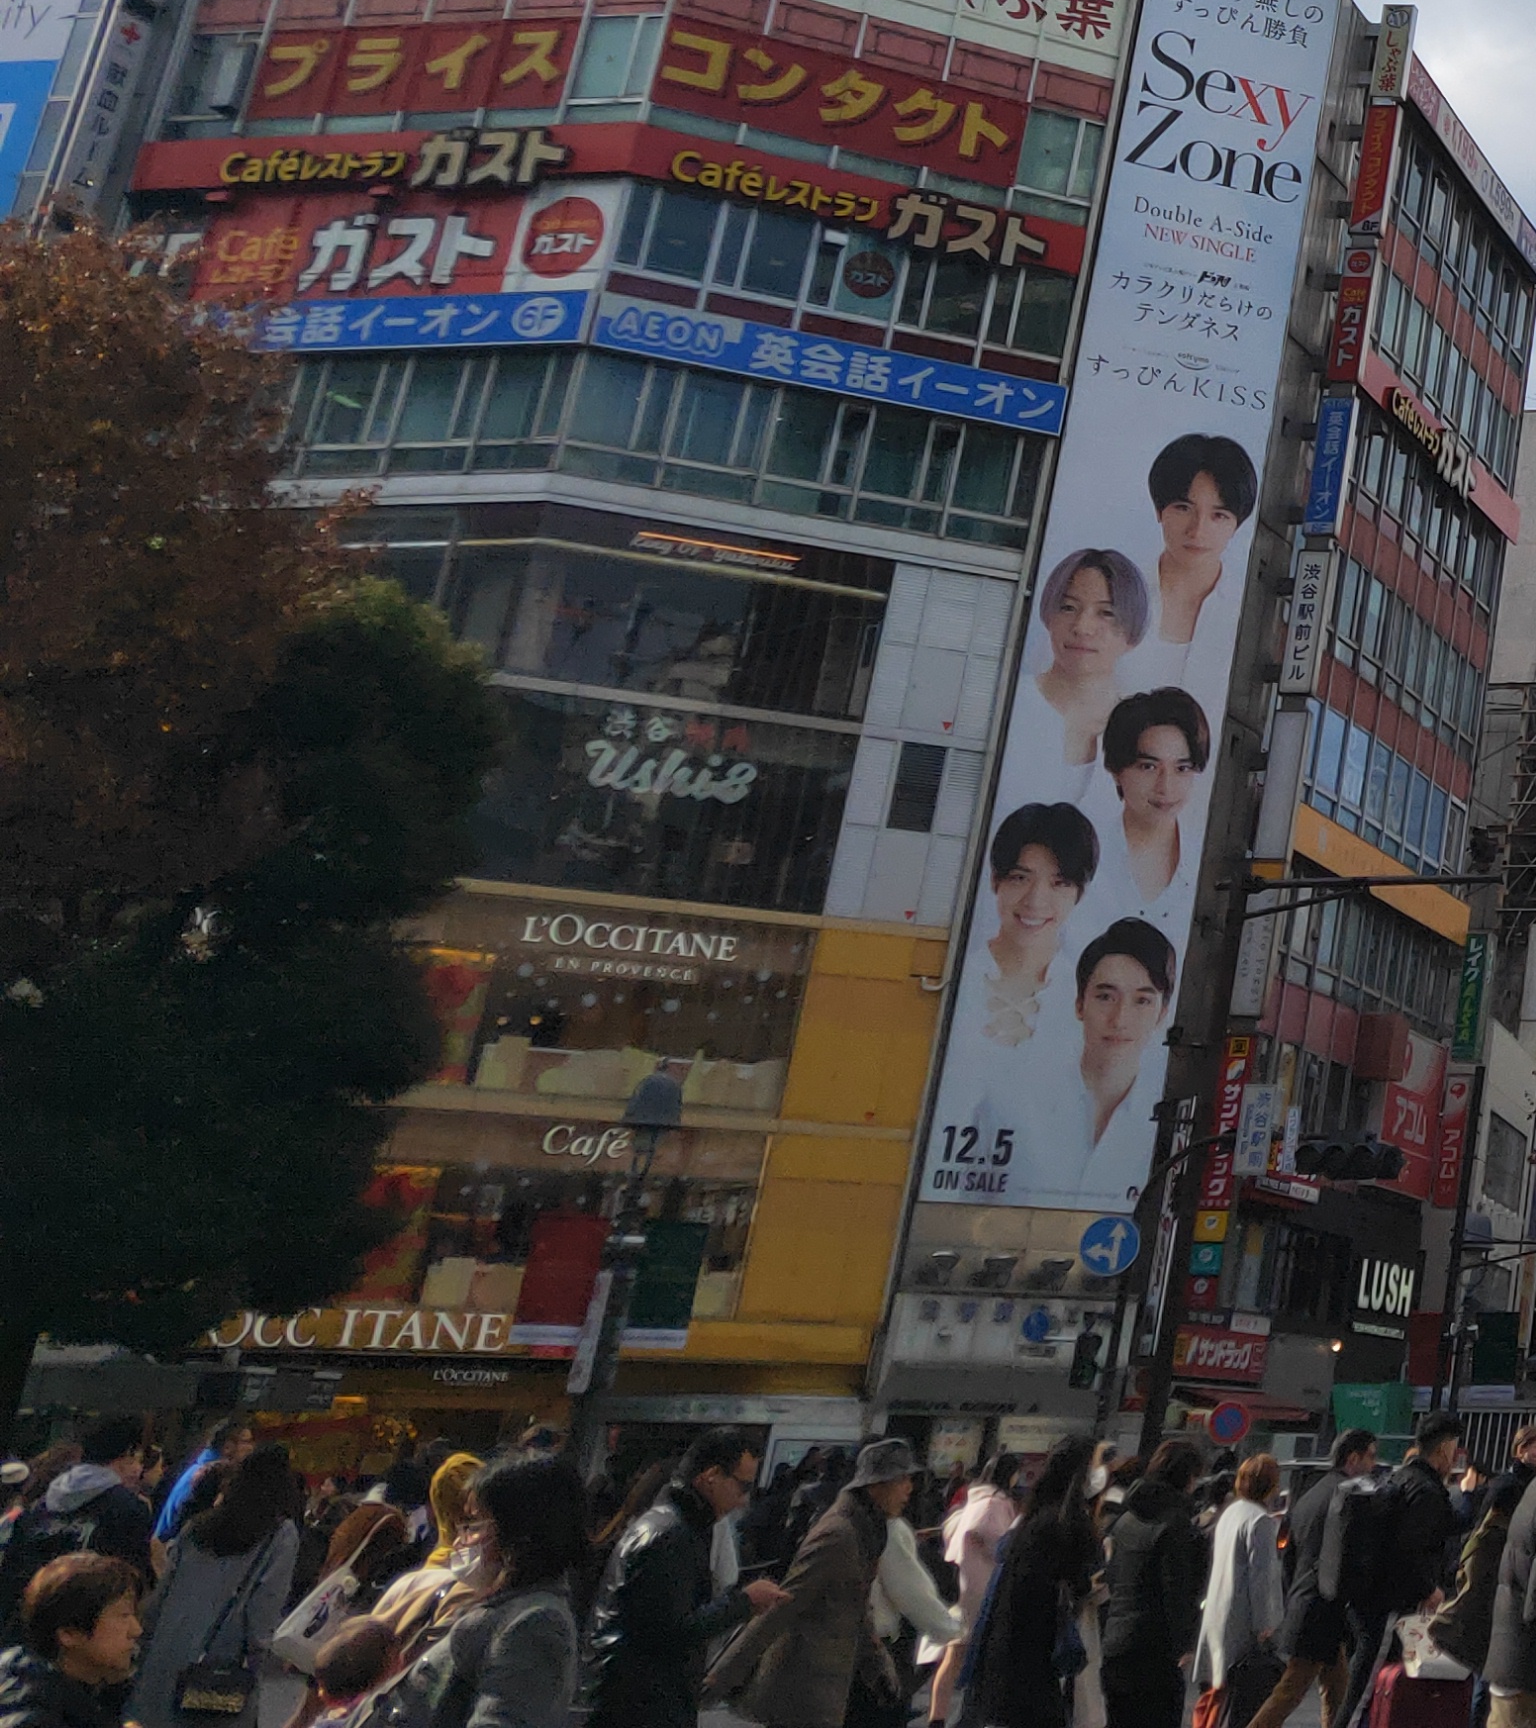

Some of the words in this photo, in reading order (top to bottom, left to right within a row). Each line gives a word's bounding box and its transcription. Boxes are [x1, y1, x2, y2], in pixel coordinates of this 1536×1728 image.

[262, 27, 564, 101] プライス
[1378, 30, 1402, 93] しゃぶ葉
[660, 27, 1009, 160] コンタクト
[1140, 30, 1316, 153] Sexy
[410, 127, 570, 187] ガスト
[1124, 101, 1303, 205] Zone
[530, 231, 596, 255] ガスト
[886, 184, 1050, 269] ガスト
[1134, 195, 1203, 229] Double
[1211, 215, 1273, 246] A-Side
[1144, 223, 1188, 246] NEW
[1190, 234, 1257, 263] SINGLE
[297, 212, 497, 295] ガスト
[1109, 271, 1273, 321] カラクリだらけの
[222, 303, 499, 344] 会話イーオン
[518, 304, 563, 334] 6F
[1133, 303, 1241, 342] テンダネス
[1337, 307, 1362, 368] ガスト
[612, 308, 724, 355] AEON
[750, 331, 1055, 419] 英会話イーオン
[1287, 563, 1322, 681] 渋谷駅前ビル
[521, 914, 739, 962] L'OCCITANE
[591, 960, 695, 982] PROVENCE
[542, 1124, 632, 1165] Café
[941, 1124, 1016, 1167] 12.5
[1439, 1129, 1461, 1179] アコム
[933, 1170, 959, 1191] ON
[962, 1172, 1010, 1193] SALE
[1357, 1257, 1415, 1318] LUSH
[208, 1308, 507, 1352] OCCITANE
